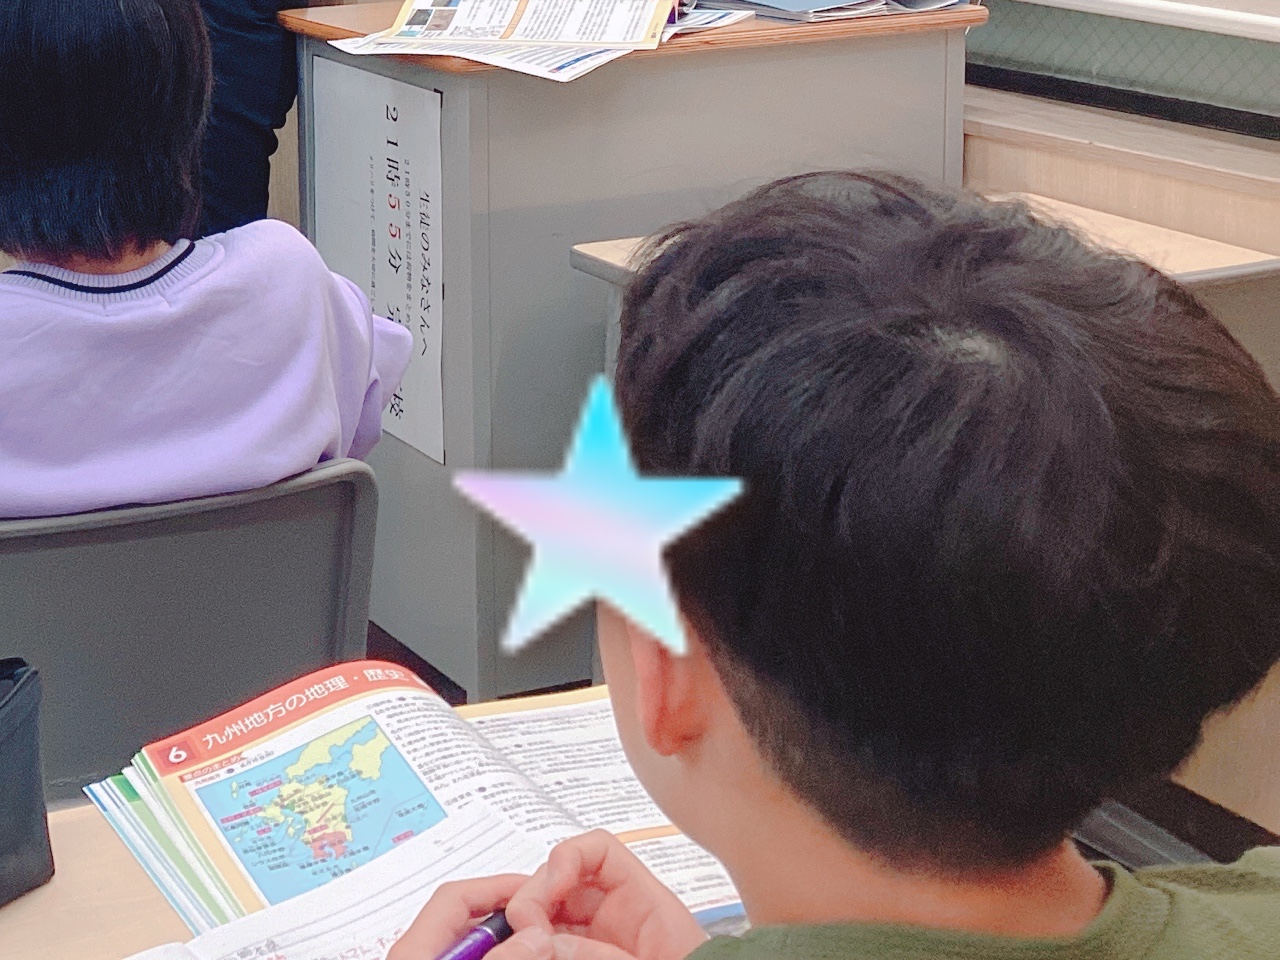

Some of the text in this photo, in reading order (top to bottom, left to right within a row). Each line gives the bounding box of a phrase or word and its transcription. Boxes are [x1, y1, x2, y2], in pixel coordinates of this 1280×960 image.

[385, 104, 405, 420] 21時55分 完校
[418, 190, 432, 357] 生徒のみなさんへ
[168, 746, 188, 764] 6
[201, 668, 409, 751] 九州地方の地理・歴史
